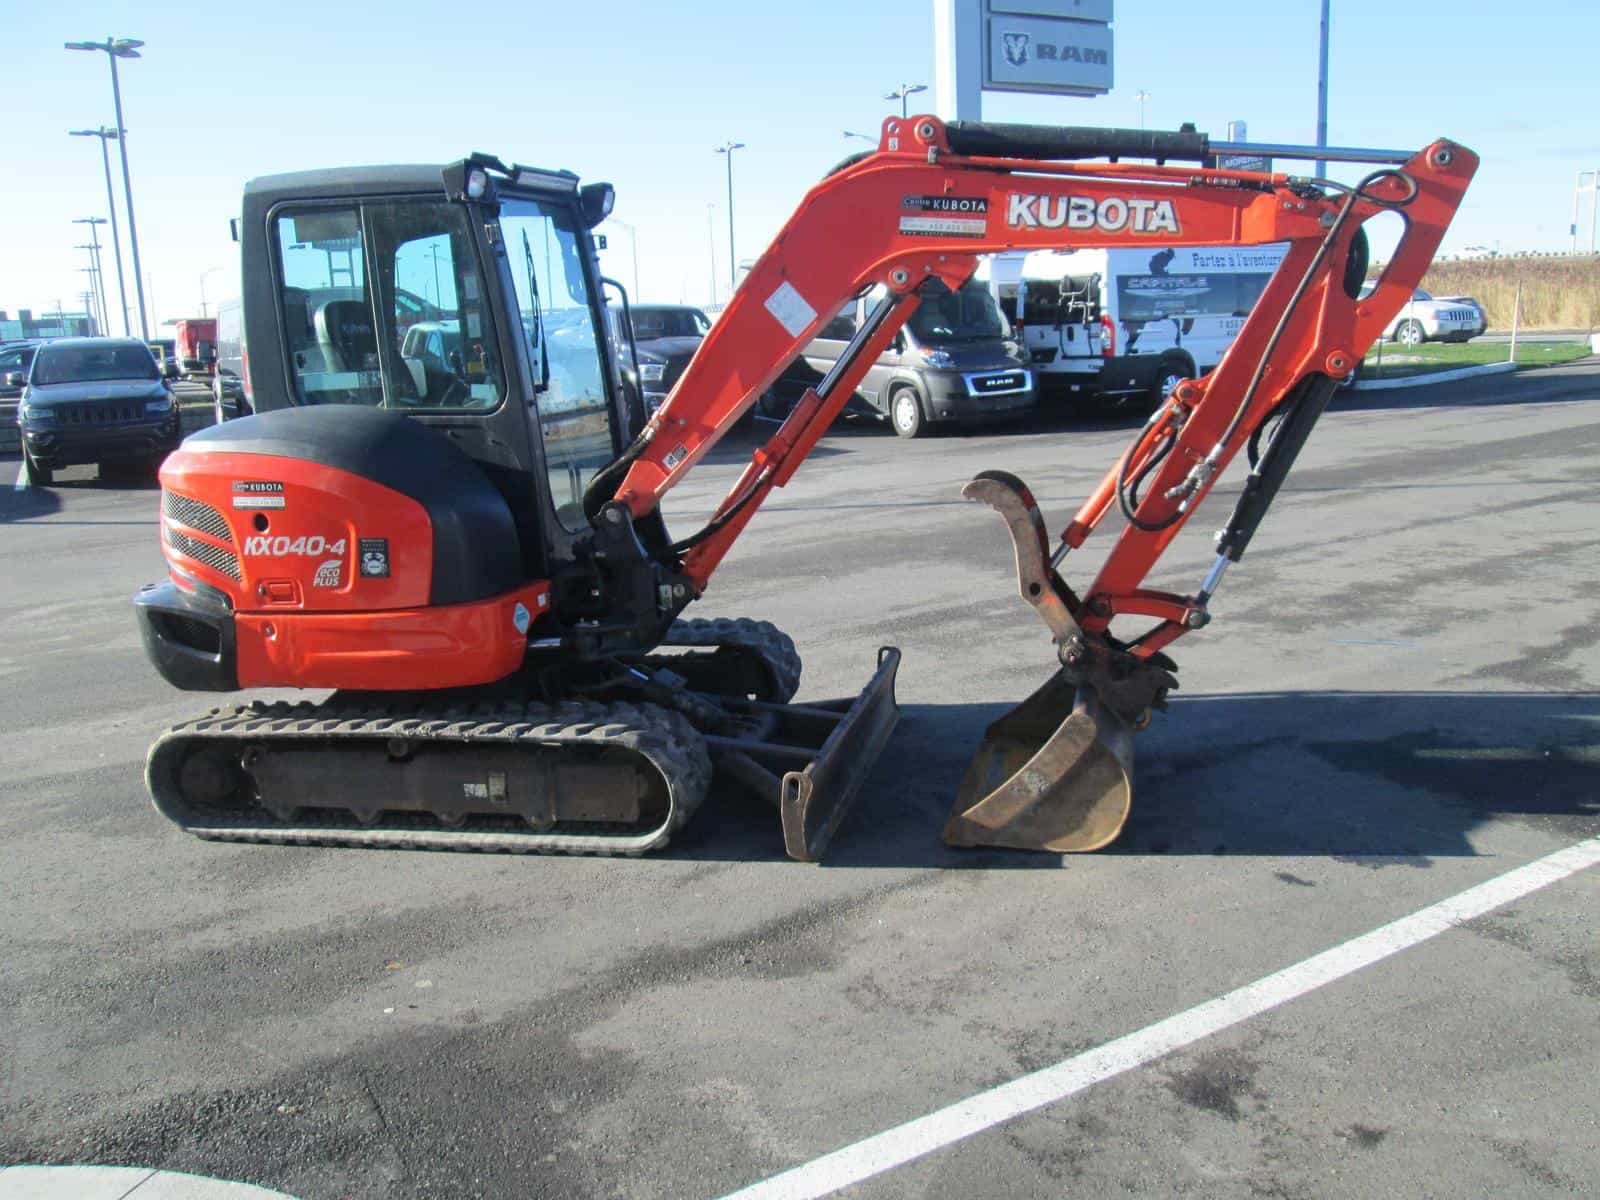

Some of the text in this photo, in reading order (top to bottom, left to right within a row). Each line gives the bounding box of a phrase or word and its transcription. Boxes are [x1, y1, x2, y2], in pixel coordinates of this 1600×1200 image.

[1037, 43, 1107, 64] RAM
[933, 199, 986, 212] KUBOTA
[1007, 194, 1178, 232] KUBOTA
[1192, 252, 1225, 267] Partez
[986, 378, 1014, 386] RAM
[250, 483, 283, 491] KUBOTA
[243, 536, 346, 556] KX040-4
[320, 568, 340, 577] eco
[313, 576, 339, 588] PLUS
